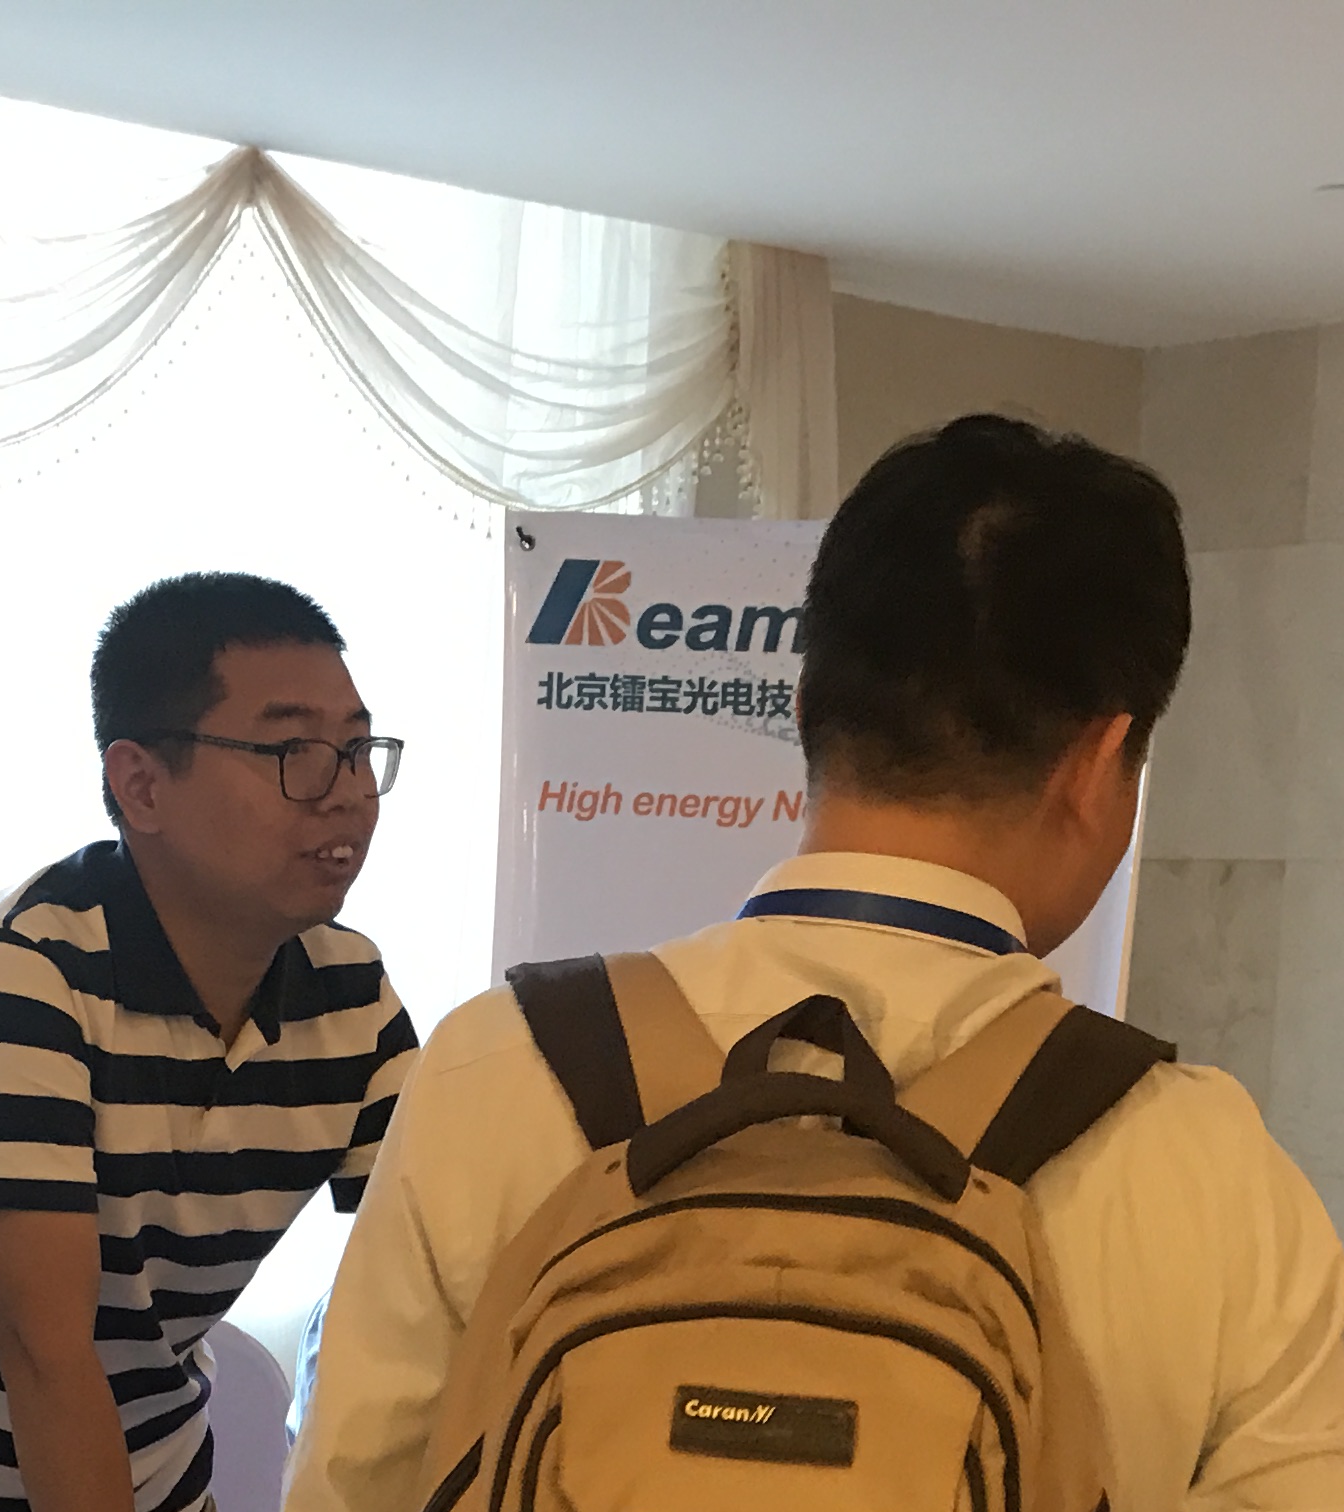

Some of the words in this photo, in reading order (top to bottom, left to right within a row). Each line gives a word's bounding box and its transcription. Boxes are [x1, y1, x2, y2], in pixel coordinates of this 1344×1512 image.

[538, 780, 623, 822] High
[632, 791, 765, 829] energy
[772, 789, 806, 822] N
